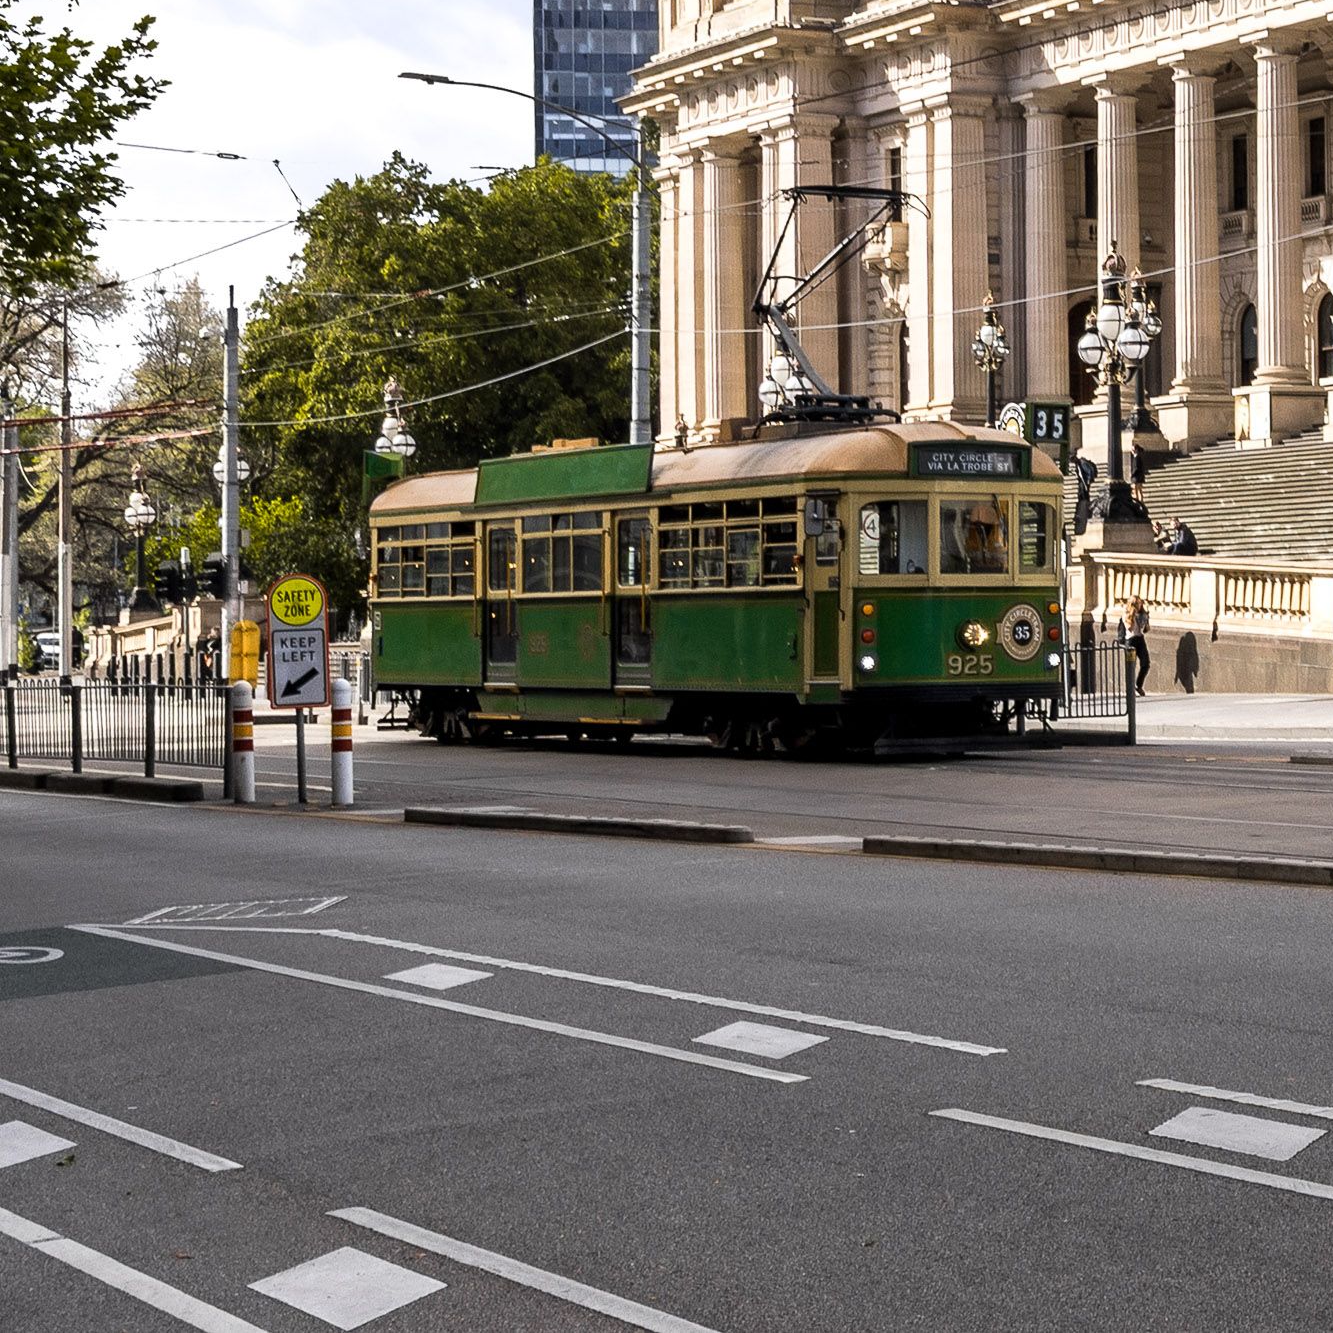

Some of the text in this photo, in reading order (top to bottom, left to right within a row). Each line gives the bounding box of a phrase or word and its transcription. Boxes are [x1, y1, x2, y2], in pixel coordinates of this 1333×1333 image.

[1036, 410, 1064, 439] 35
[932, 452, 993, 462] CITY CIRCLE
[928, 462, 1009, 471] VIA LA TROBE ST
[276, 589, 316, 603] SAFETY
[284, 604, 311, 617] ZONE
[1014, 626, 1030, 640] 35
[280, 636, 316, 649] KEEP
[282, 650, 315, 663] LEFT
[948, 654, 993, 675] 925
